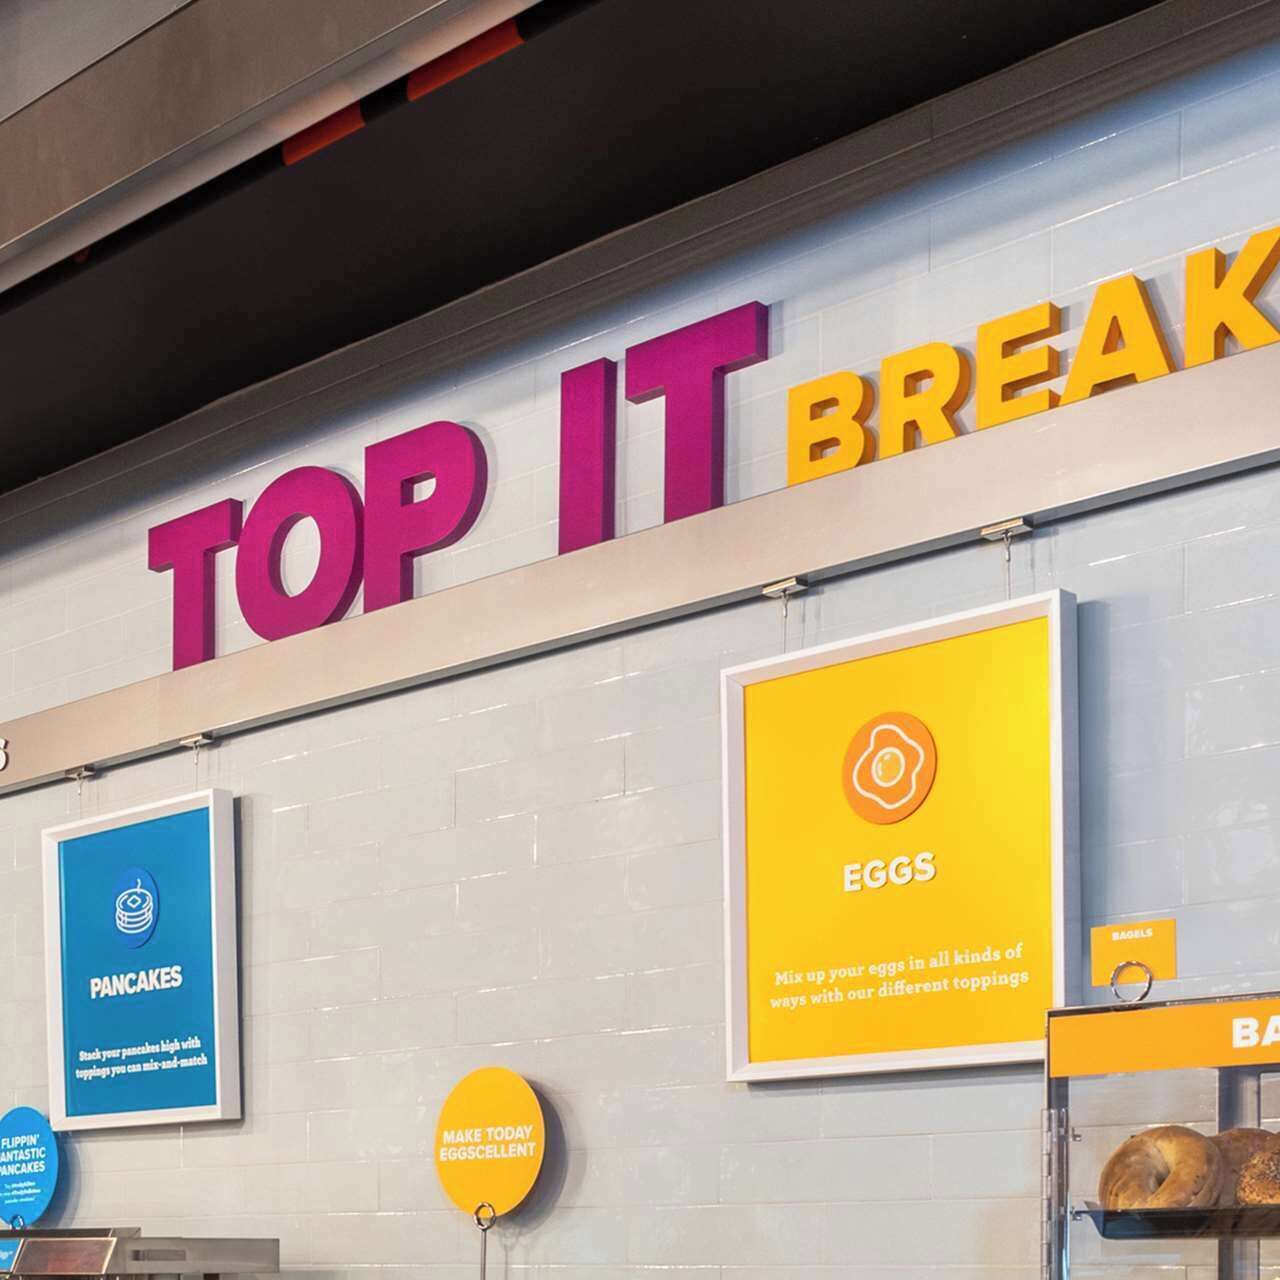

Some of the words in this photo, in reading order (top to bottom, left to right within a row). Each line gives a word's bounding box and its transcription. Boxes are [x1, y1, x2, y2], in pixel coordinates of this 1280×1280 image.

[148, 420, 488, 672] TOP
[558, 301, 768, 555] IT
[843, 851, 938, 892] EGGS
[1111, 927, 1153, 941] BAGELS
[775, 971, 803, 986] Mix
[807, 970, 825, 985] up
[829, 965, 865, 984] your
[868, 961, 905, 979] eggs
[909, 955, 925, 971] in
[928, 951, 950, 969] all
[954, 945, 1000, 966] kinds
[1005, 942, 1024, 960] of
[90, 965, 183, 999] PANCAKES
[770, 996, 807, 1010] ways
[810, 988, 843, 1005] with
[847, 986, 874, 1001] our
[878, 977, 949, 998] different
[953, 970, 1029, 991] toppings
[79, 1048, 101, 1061] Stack
[102, 1050, 120, 1061] your
[121, 1042, 160, 1059] pancakes
[160, 1039, 180, 1054] high
[181, 1036, 201, 1050] with
[75, 1065, 110, 1080] toppings
[111, 1065, 126, 1078] you
[127, 1064, 142, 1073] can
[143, 1053, 208, 1071] mix-and-match
[1, 1134, 40, 1149] FLIPPIN'
[443, 1128, 482, 1144] MAKE
[486, 1124, 533, 1141] TODAY
[440, 1142, 536, 1161] EGGSCELLENT
